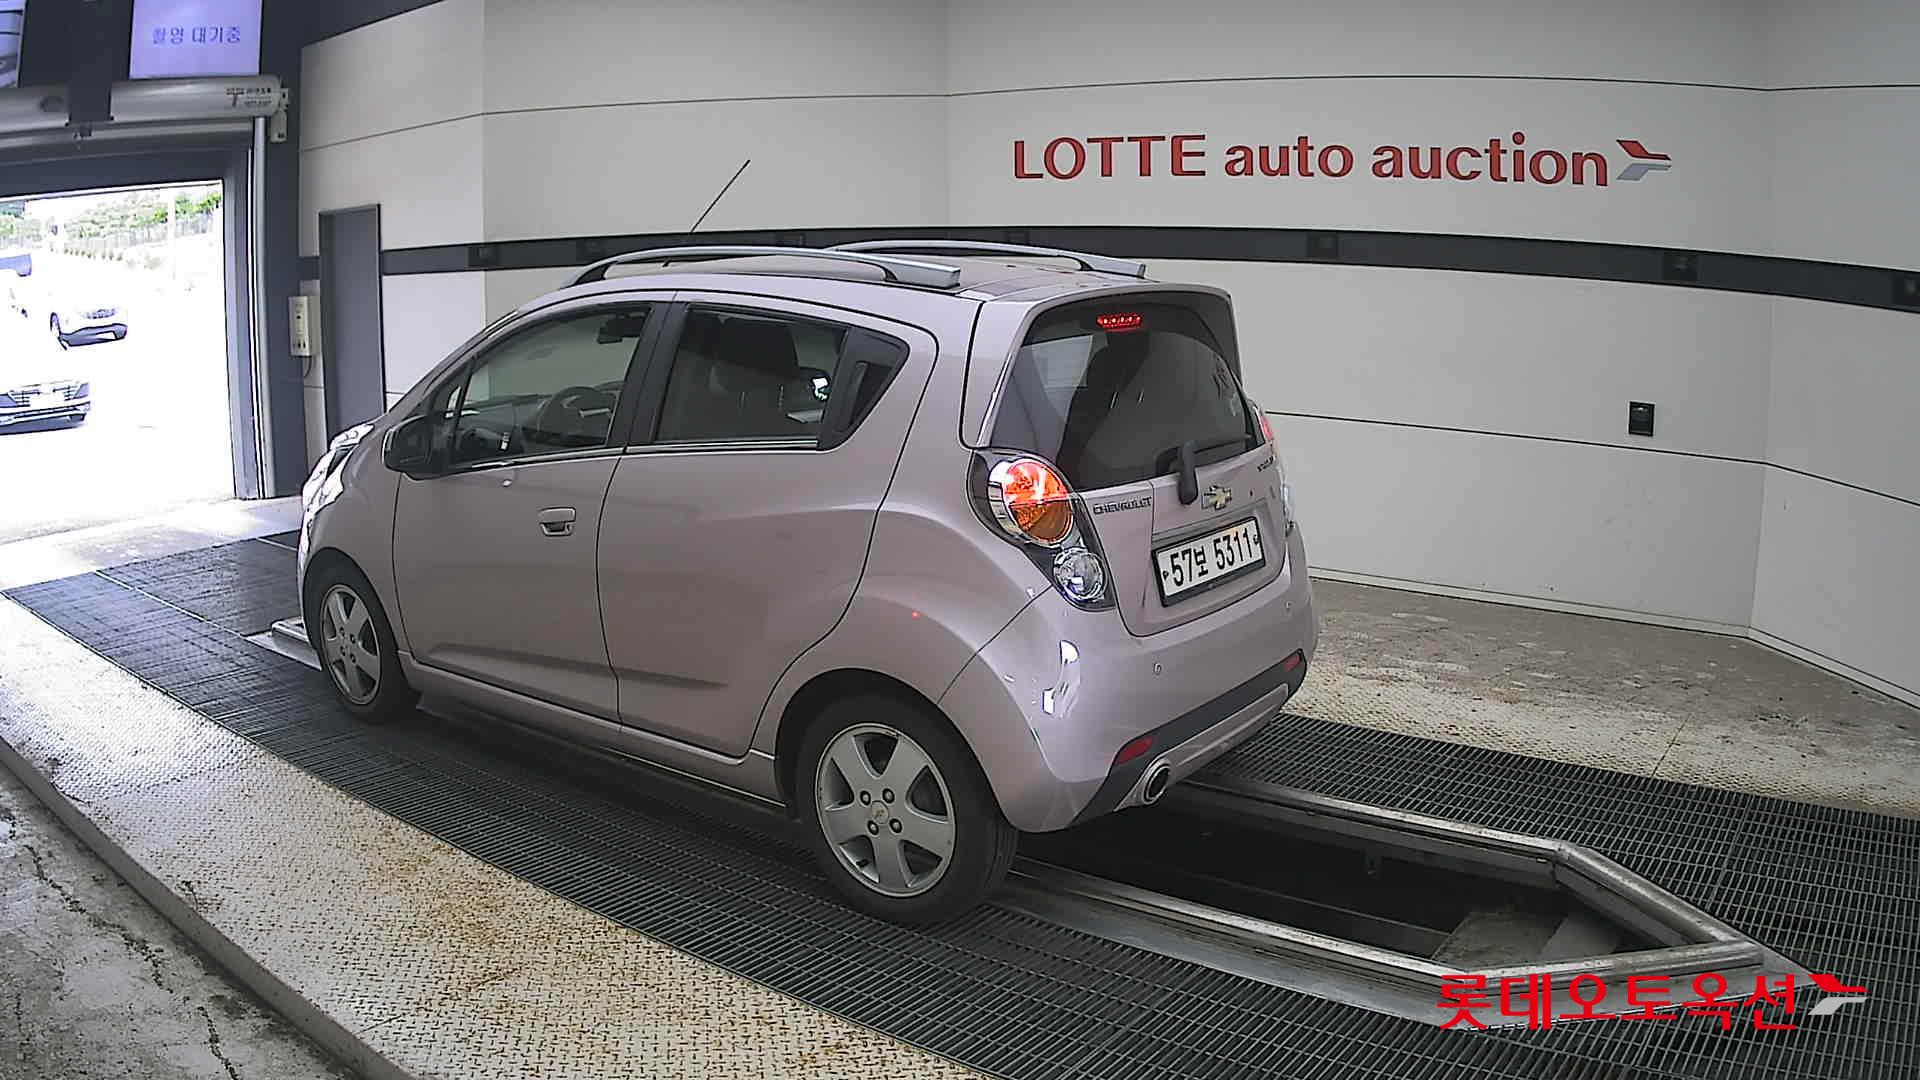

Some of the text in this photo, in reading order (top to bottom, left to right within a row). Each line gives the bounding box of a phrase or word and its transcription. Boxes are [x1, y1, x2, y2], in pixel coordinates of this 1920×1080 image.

[1014, 131, 1609, 187] LOTTE auto auction
[1093, 496, 1153, 515] CHEVROLET
[1169, 527, 1253, 587] 57보 5311
